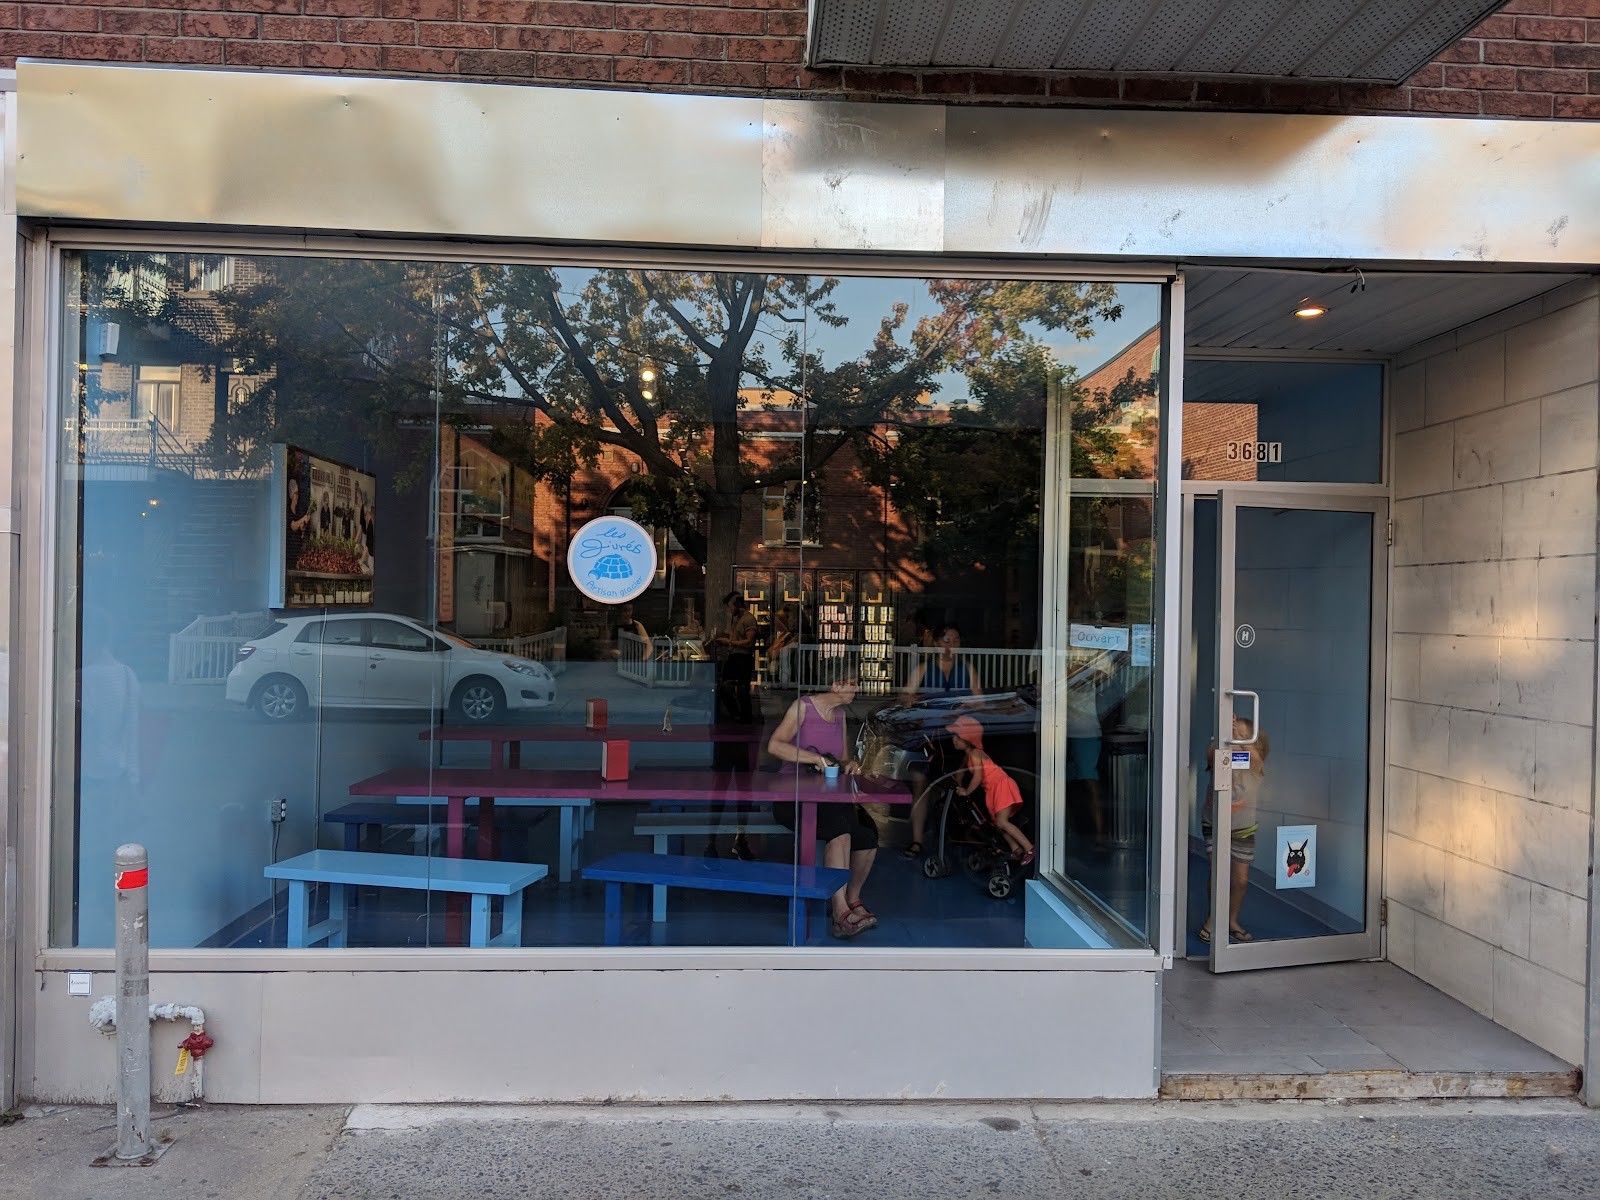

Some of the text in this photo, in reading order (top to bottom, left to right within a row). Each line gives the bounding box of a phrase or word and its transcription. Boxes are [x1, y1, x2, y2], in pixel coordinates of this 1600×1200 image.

[1228, 442, 1279, 461] 3681
[586, 575, 644, 597] Artisan glacier
